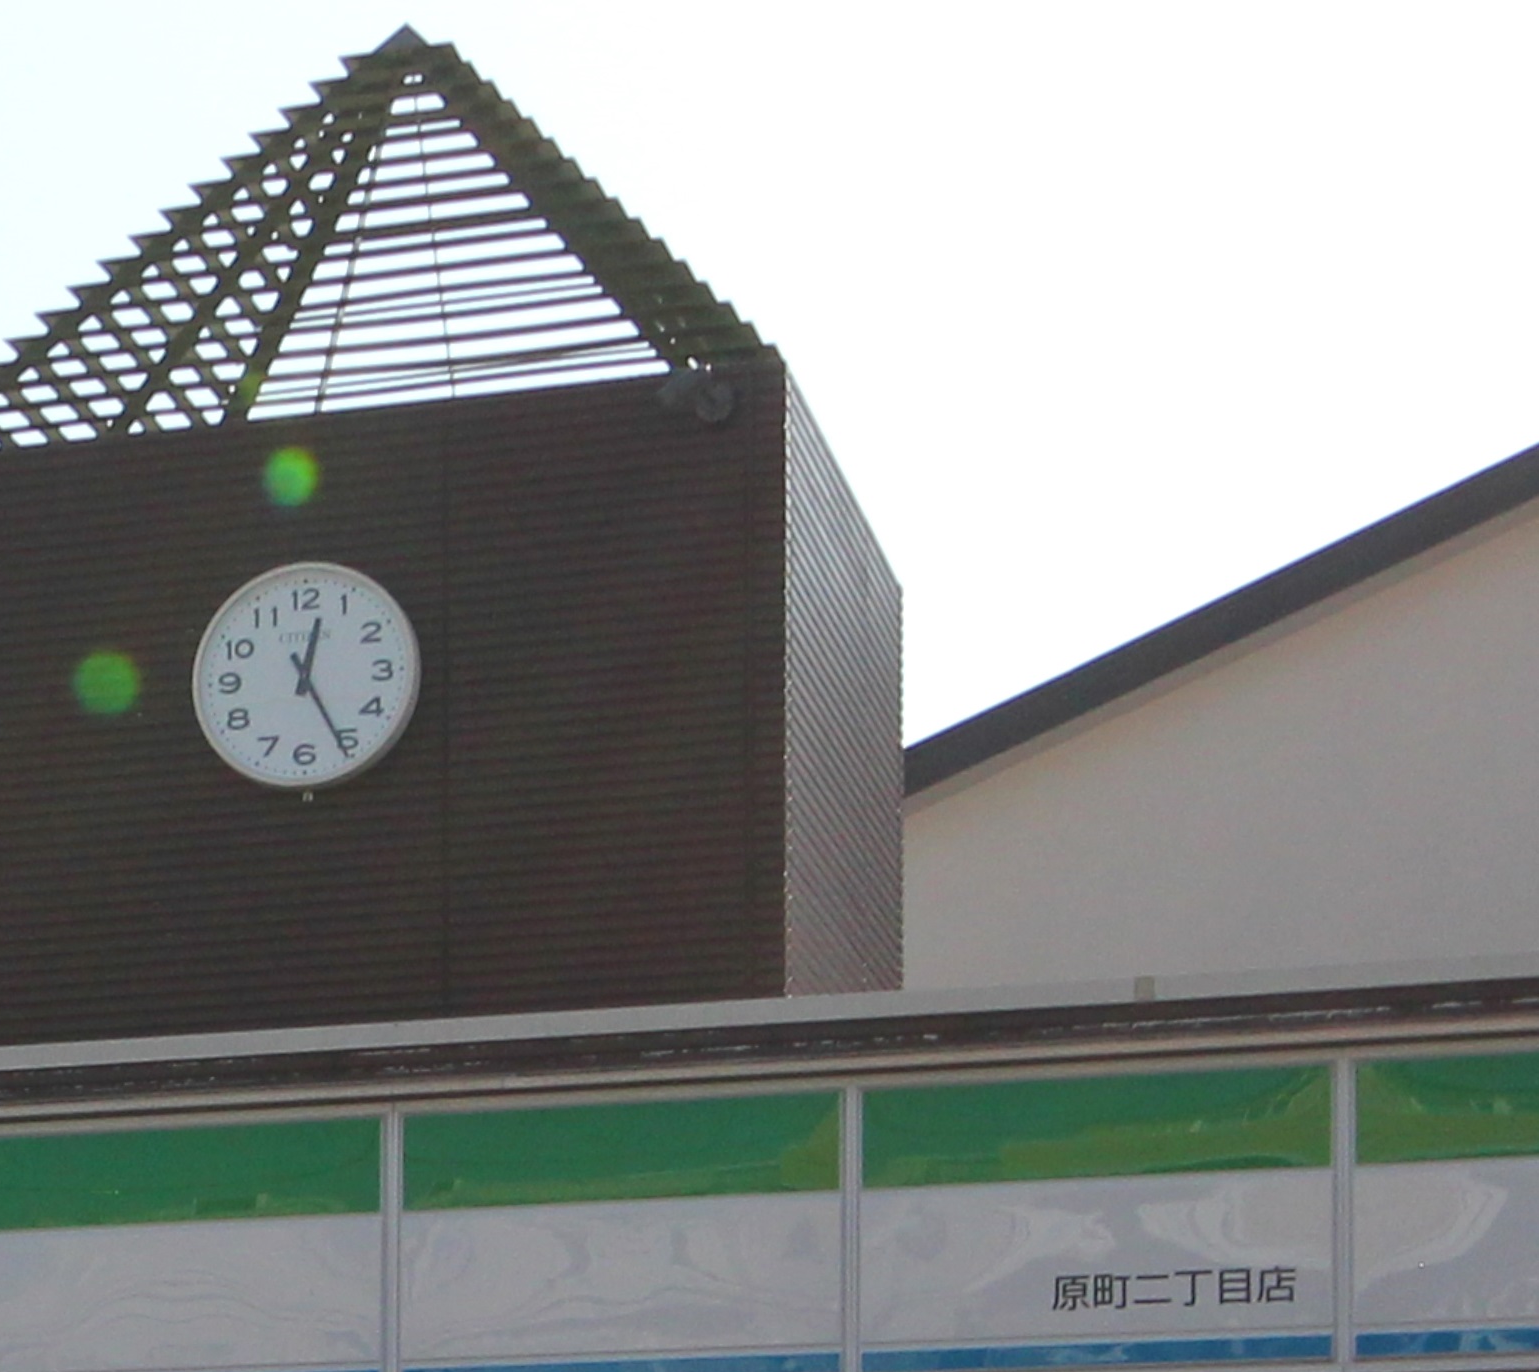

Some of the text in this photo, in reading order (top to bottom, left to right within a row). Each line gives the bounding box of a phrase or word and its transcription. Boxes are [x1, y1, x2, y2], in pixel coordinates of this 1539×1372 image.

[292, 588, 321, 611] 12
[341, 594, 348, 615] 1
[253, 607, 278, 628] 11
[360, 622, 382, 644] 2
[225, 639, 255, 661] 10
[372, 659, 393, 681] 3
[218, 672, 242, 694] 9
[358, 696, 384, 717] 4
[226, 708, 250, 730] 8
[257, 735, 280, 758] 7
[336, 728, 359, 751] 5
[292, 744, 316, 766] 6
[1052, 1266, 1297, 1311] 原町二丁目店
